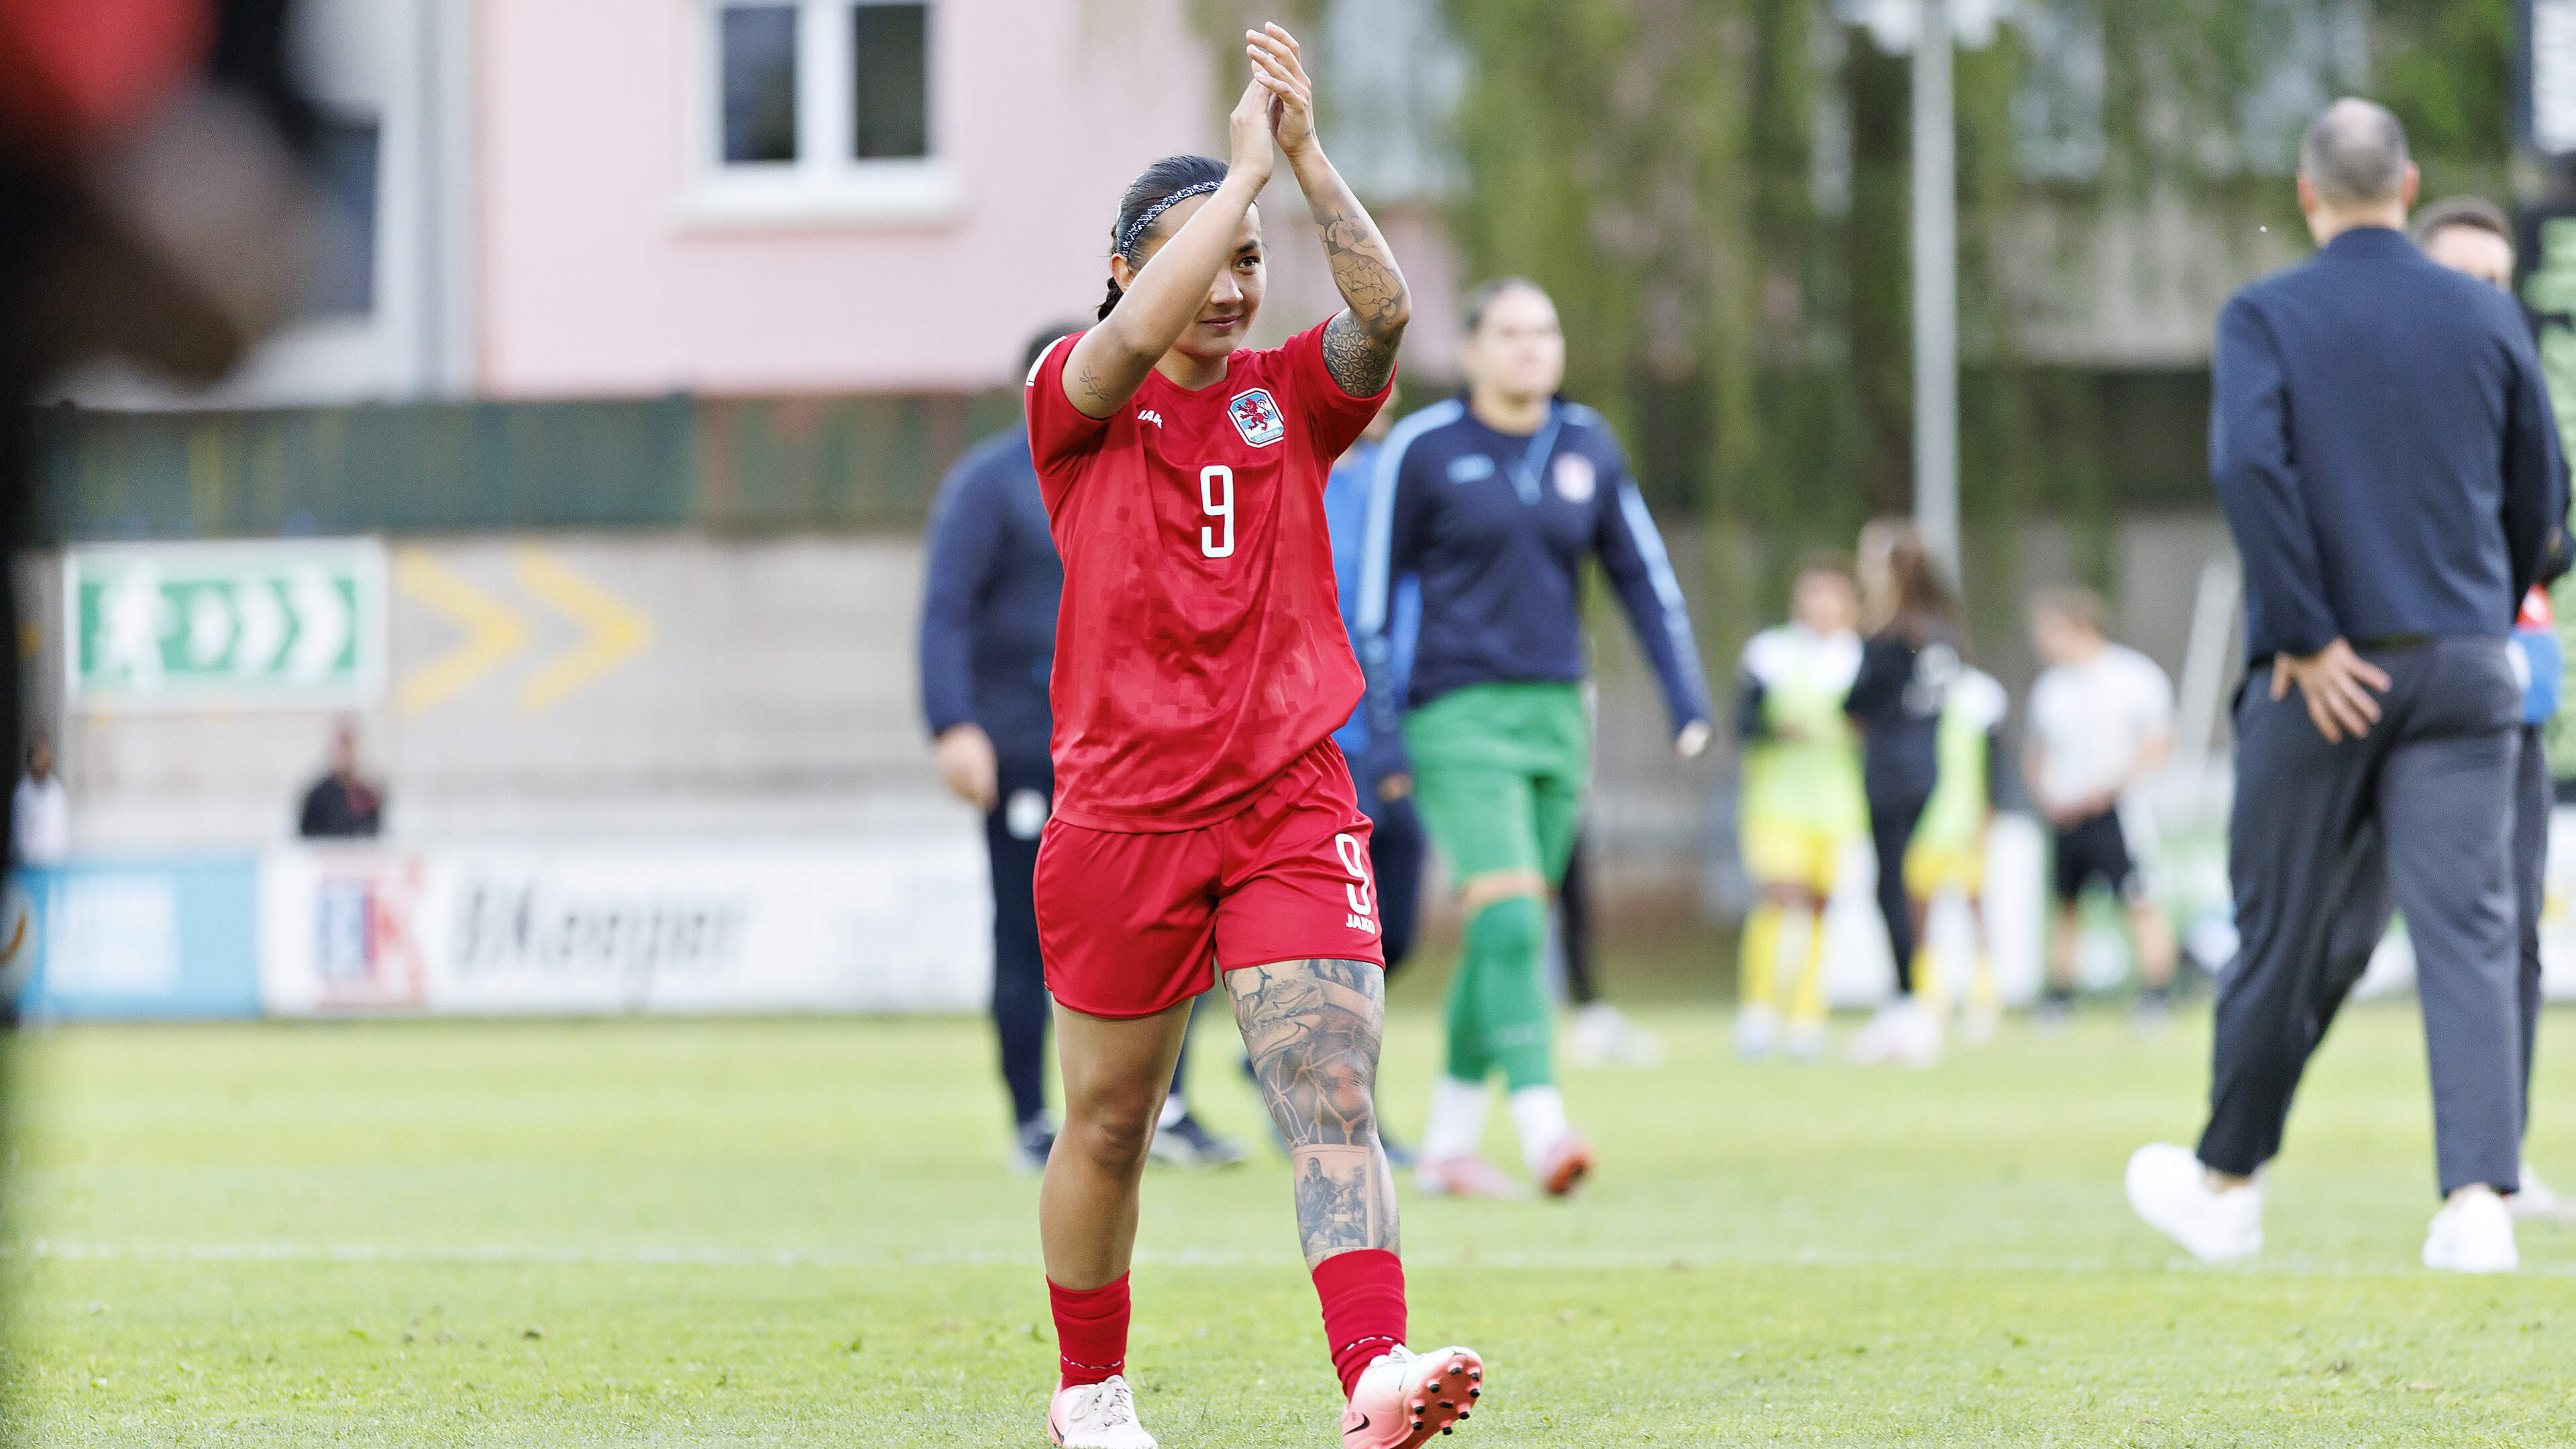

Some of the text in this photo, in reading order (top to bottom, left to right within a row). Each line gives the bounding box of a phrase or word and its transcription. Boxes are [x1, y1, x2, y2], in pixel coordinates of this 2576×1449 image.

[1199, 465, 1235, 558] 9
[1335, 833, 1372, 916] 9
[1345, 913, 1376, 935] JAKO
